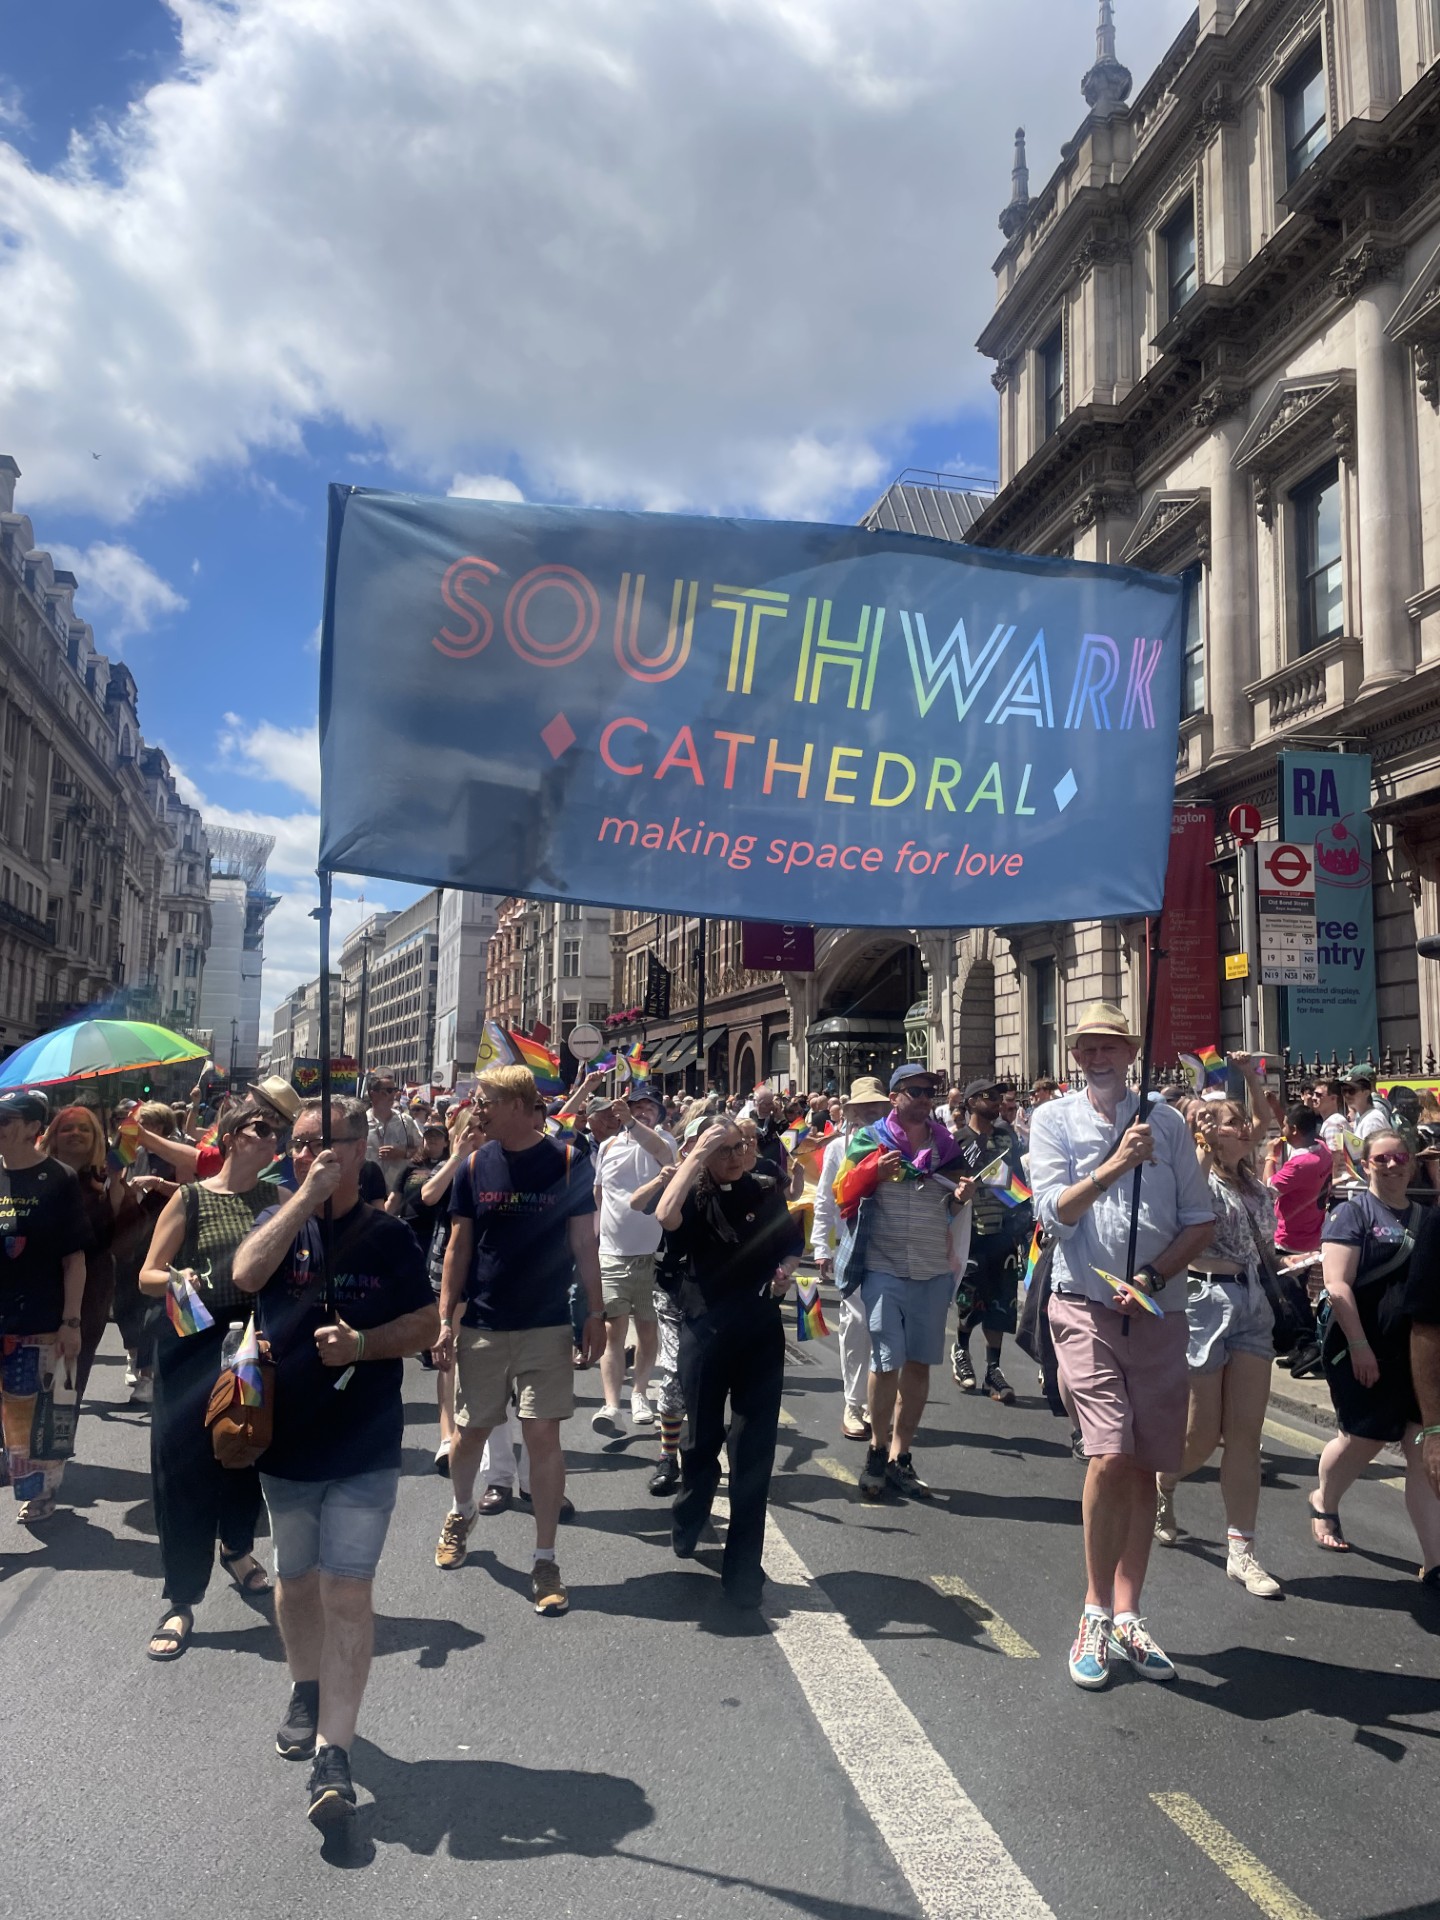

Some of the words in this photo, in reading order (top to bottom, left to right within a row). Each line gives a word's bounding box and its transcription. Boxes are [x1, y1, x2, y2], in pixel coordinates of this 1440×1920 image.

[431, 556, 1163, 731] SOUTHWARK
[600, 716, 1037, 816] CATHEDRAL
[1292, 768, 1341, 817] RA
[1172, 812, 1206, 824] ngton
[1240, 809, 1254, 833] L
[1171, 825, 1184, 834] se
[599, 814, 757, 870] making
[765, 837, 884, 878] space
[895, 840, 951, 877] for
[955, 844, 1024, 878] love
[1317, 921, 1359, 940] ree
[1317, 942, 1365, 971] ntry
[1284, 972, 1298, 980] N38
[1296, 986, 1328, 994] selected
[1297, 997, 1320, 1005] shops
[0, 1208, 31, 1217] edral
